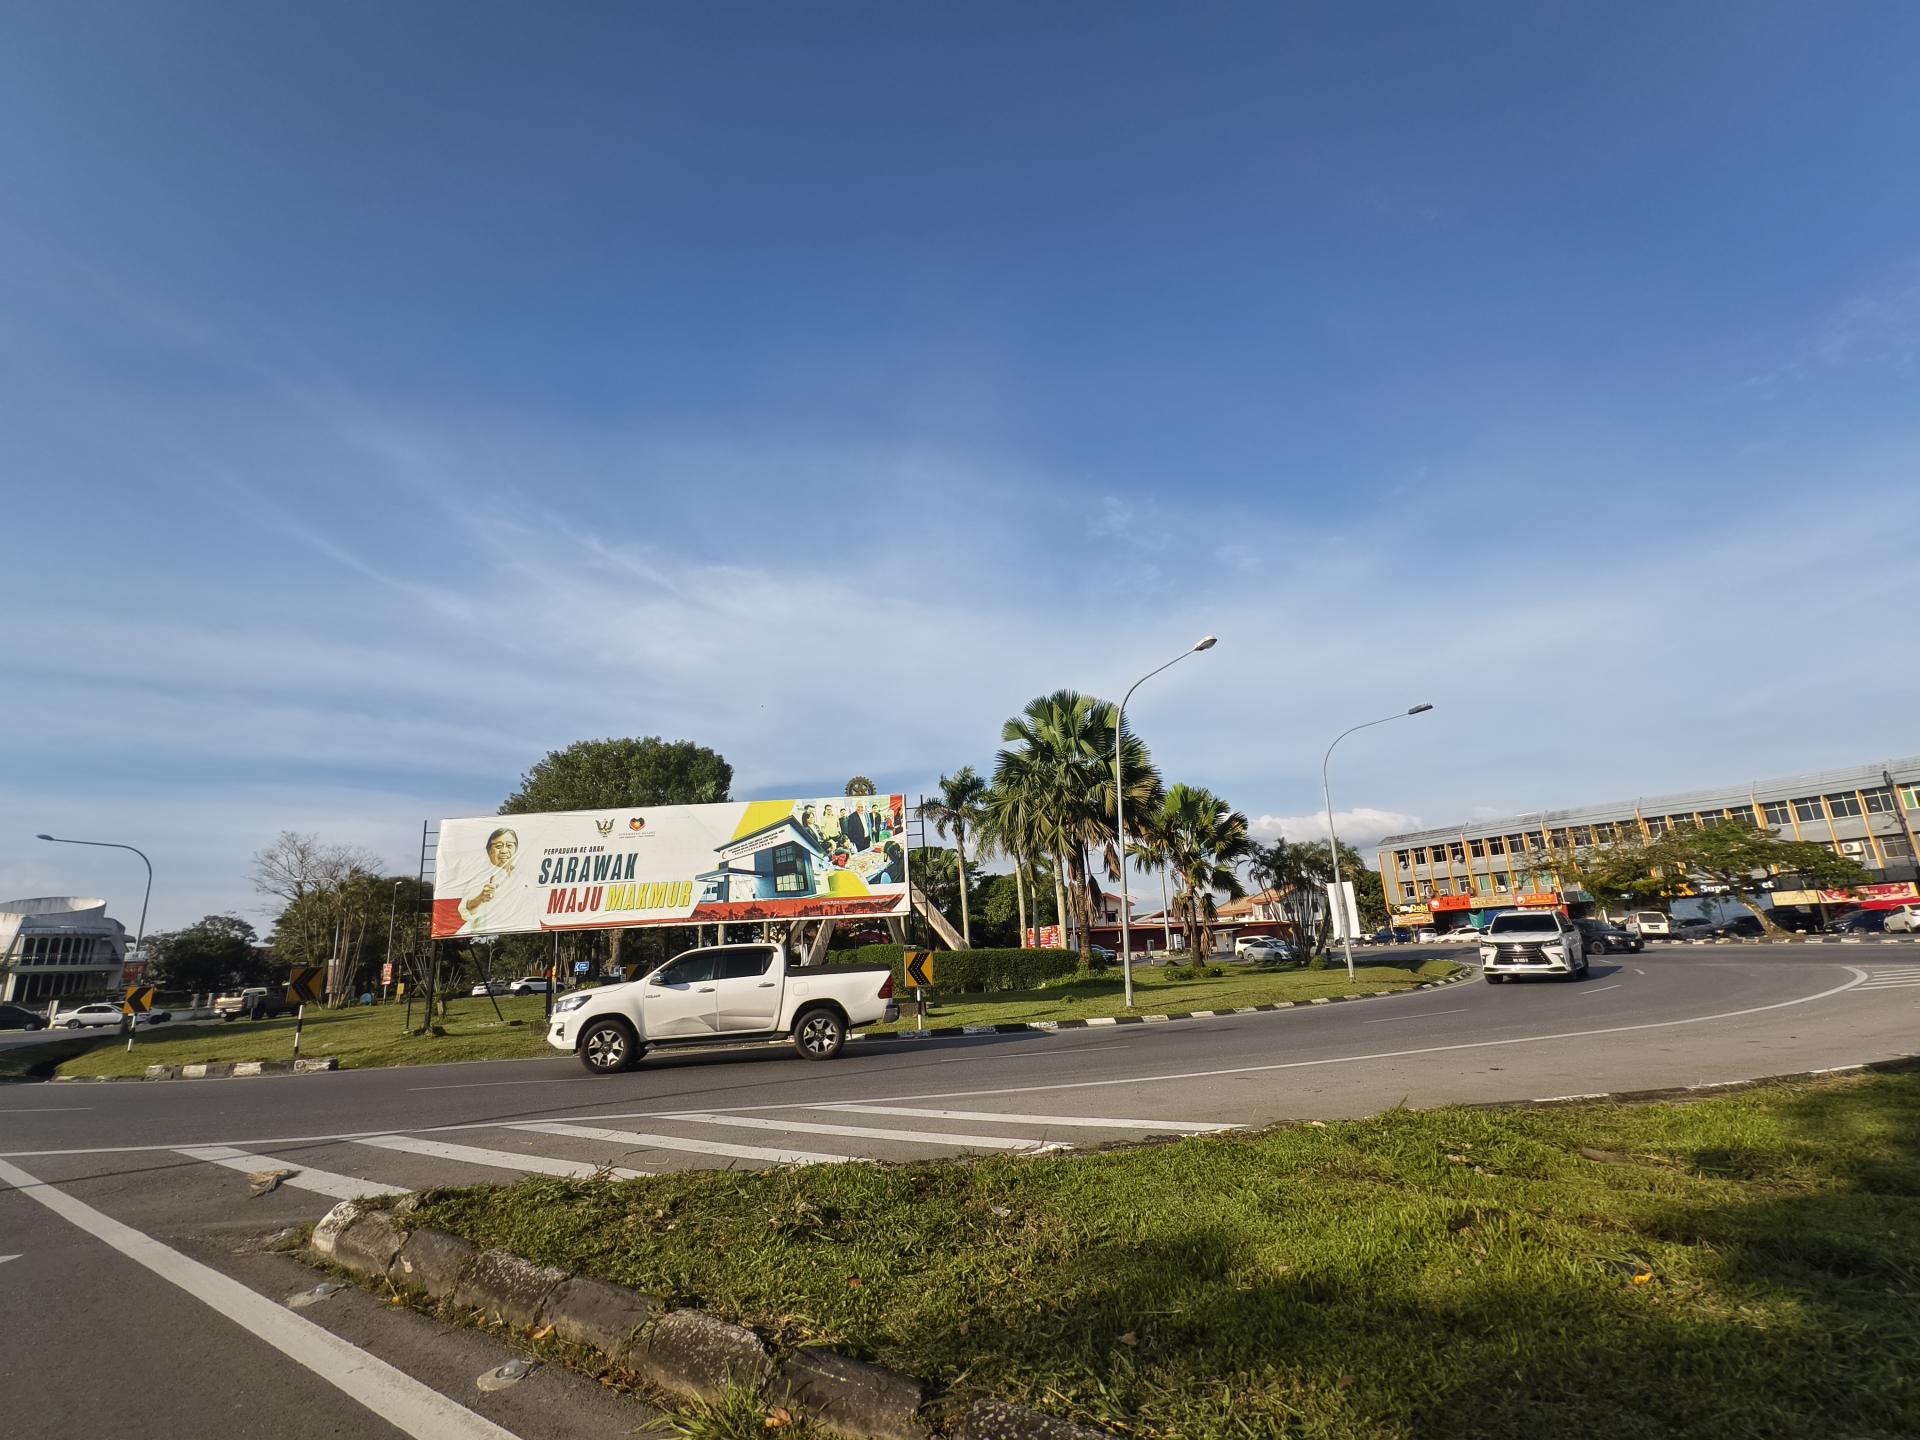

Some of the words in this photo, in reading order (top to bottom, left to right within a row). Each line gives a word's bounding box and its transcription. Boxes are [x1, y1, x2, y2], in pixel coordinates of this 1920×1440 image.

[538, 853, 638, 885] SARAWAK
[546, 886, 604, 914] MAJU
[605, 880, 693, 911] MAKMUR
